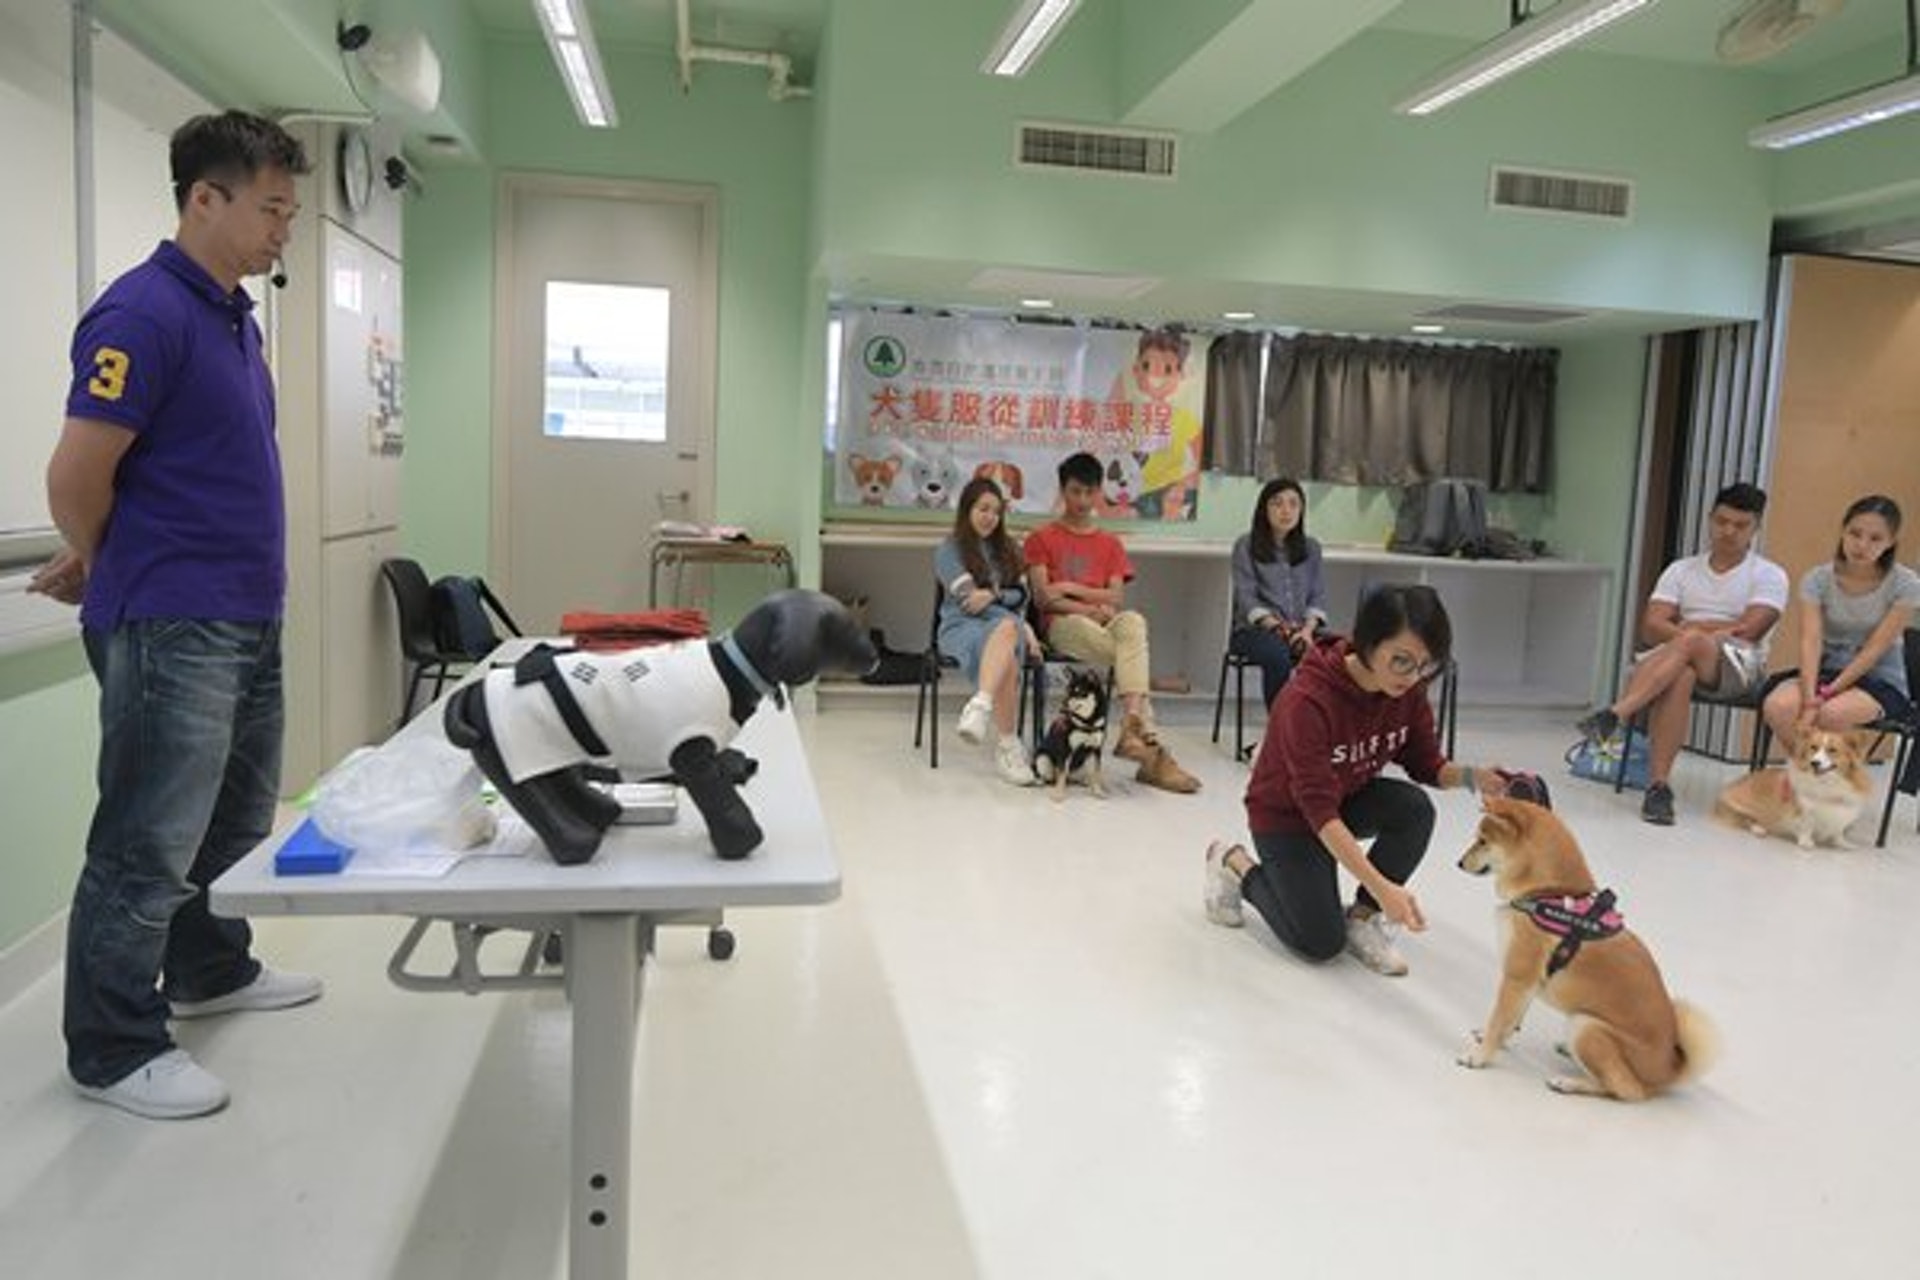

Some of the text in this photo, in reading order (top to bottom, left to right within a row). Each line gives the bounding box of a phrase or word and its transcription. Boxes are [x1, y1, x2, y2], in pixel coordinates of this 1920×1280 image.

[88, 346, 130, 400] 3
[869, 385, 1173, 436] 犬隻服從訓練課程
